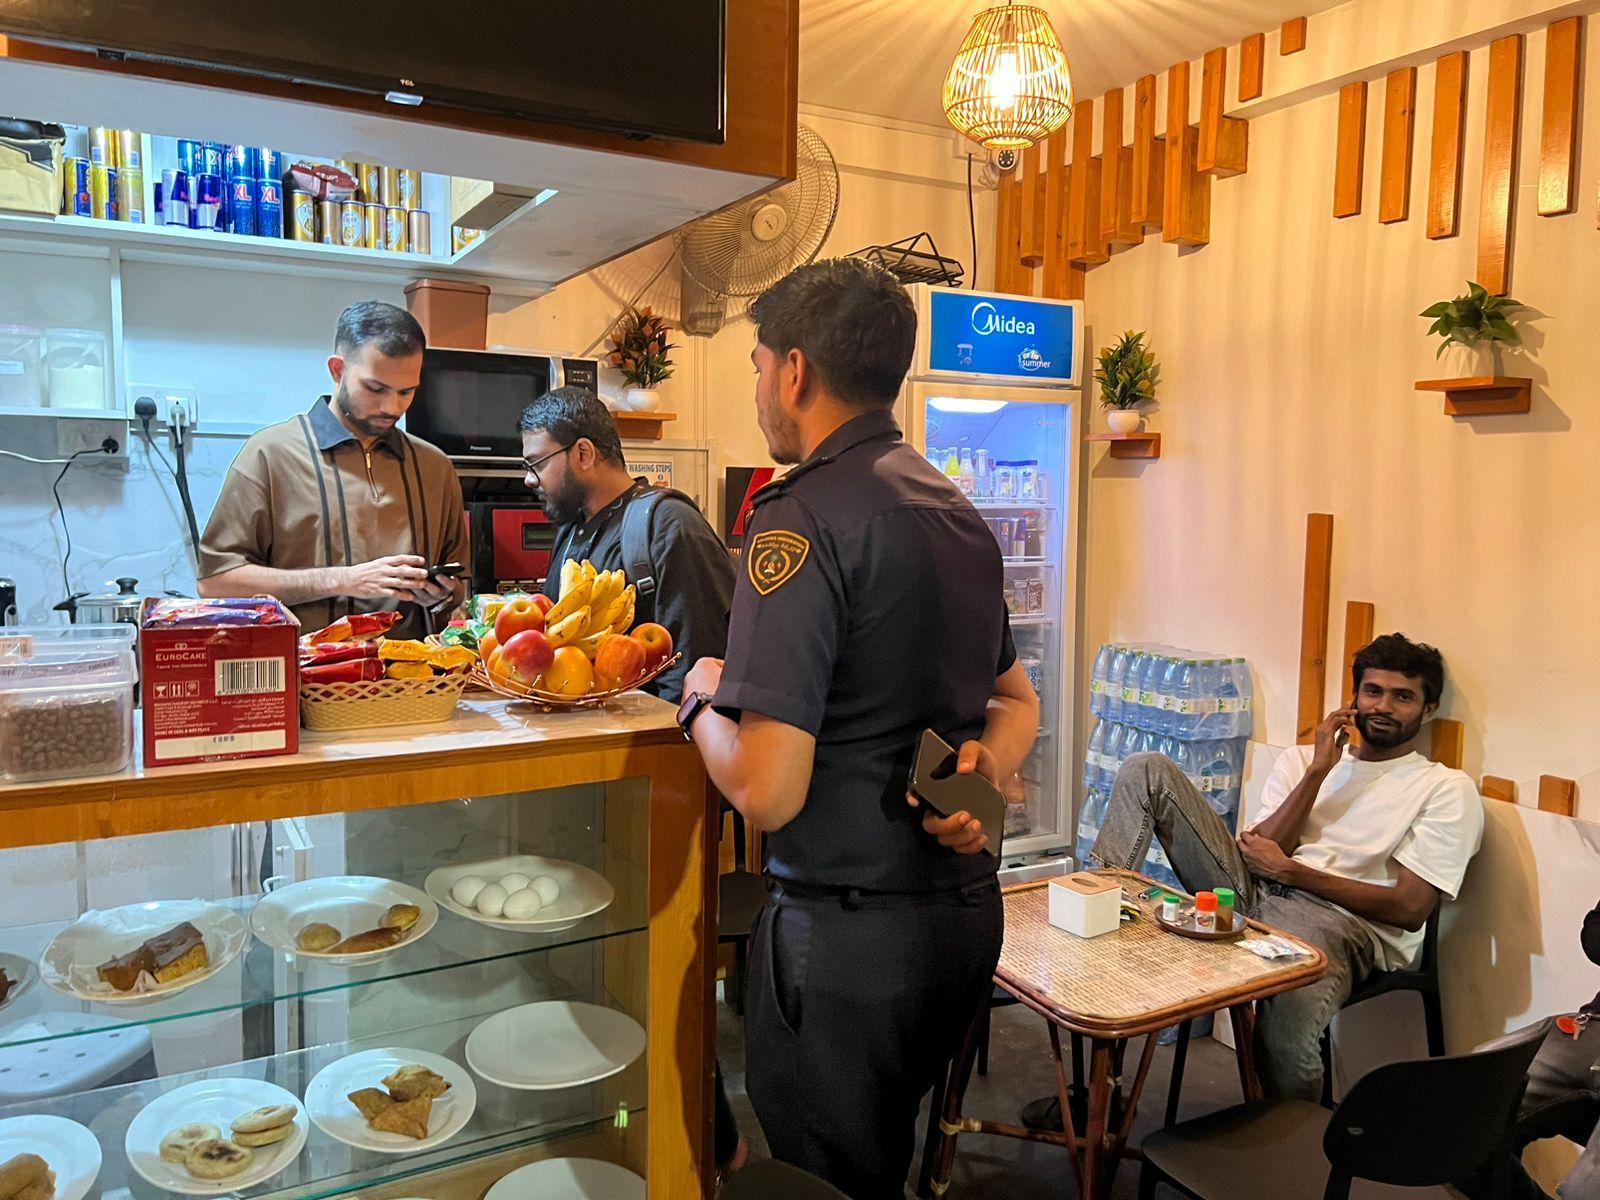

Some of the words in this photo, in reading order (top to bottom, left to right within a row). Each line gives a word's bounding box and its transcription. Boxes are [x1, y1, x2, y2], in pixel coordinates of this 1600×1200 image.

[233, 183, 252, 201] XL
[261, 185, 281, 204] XL
[972, 302, 1035, 336] Midea
[1022, 360, 1051, 368] summer
[629, 464, 655, 473] WASHING
[656, 464, 672, 473] STEPS
